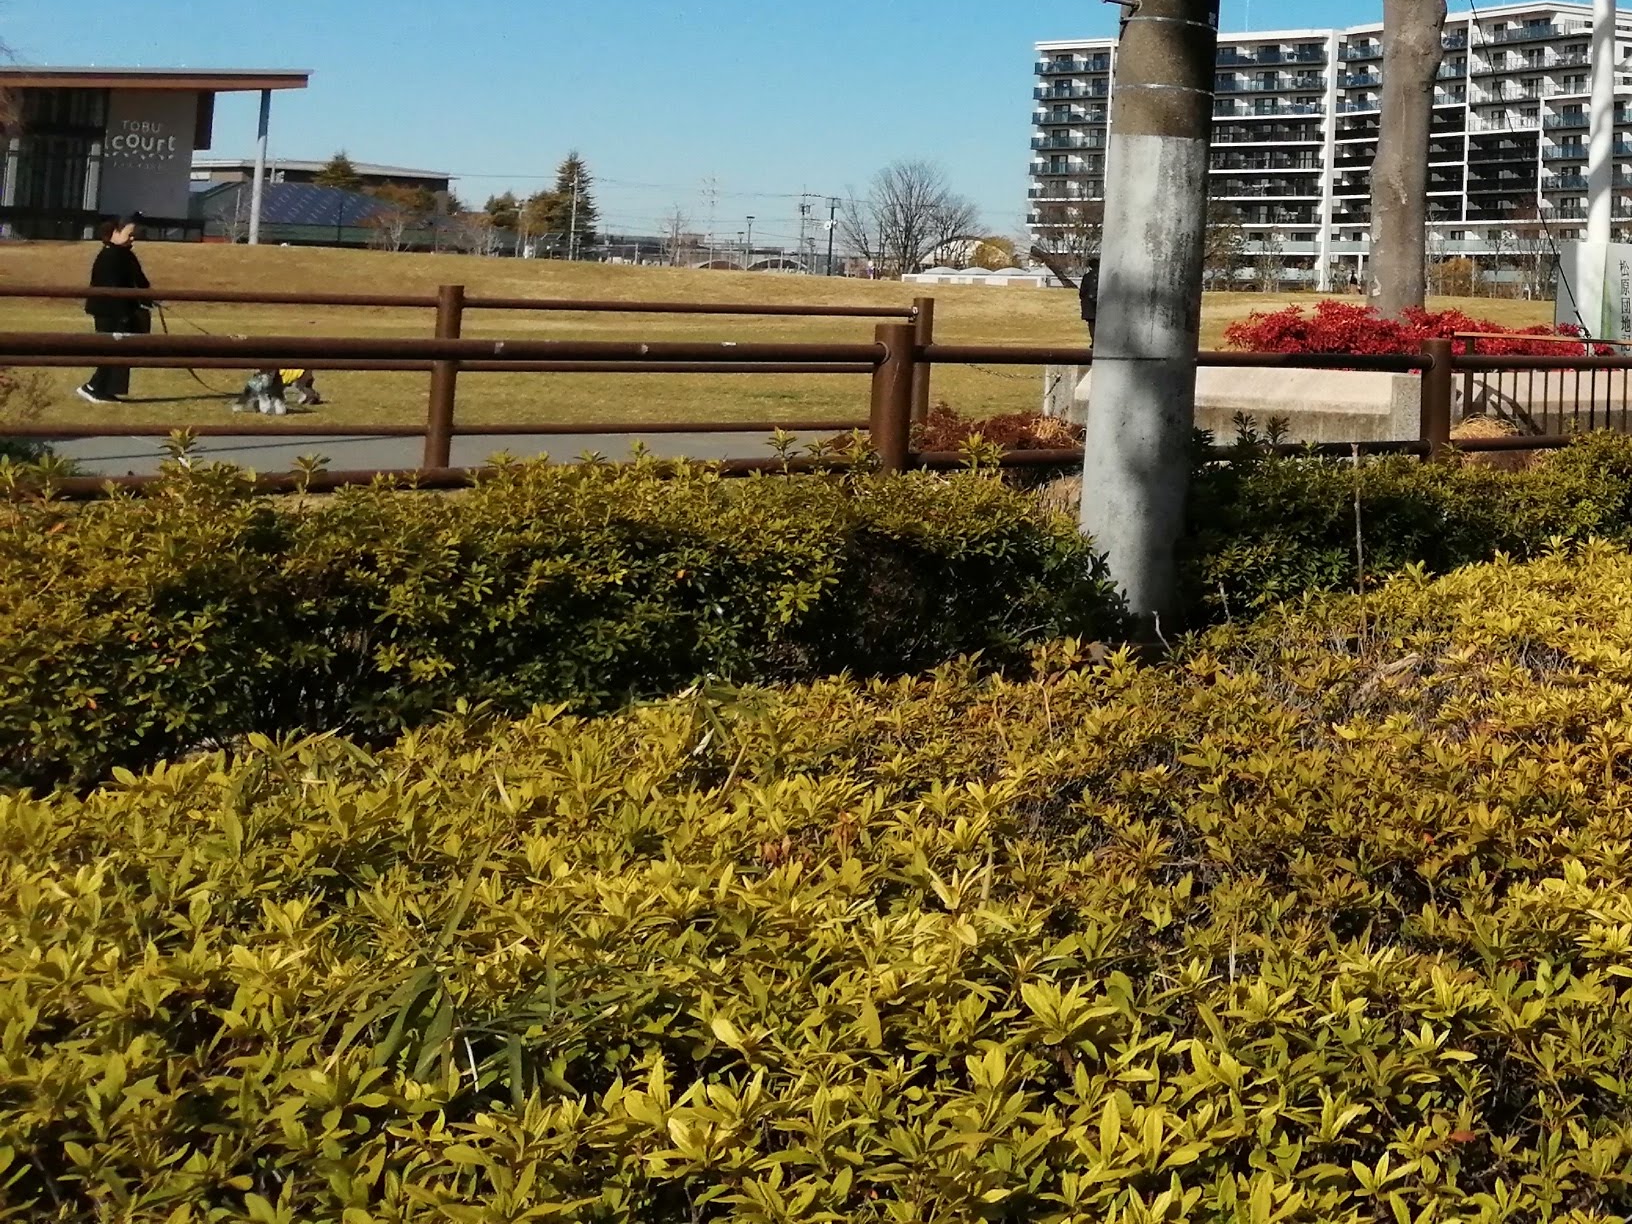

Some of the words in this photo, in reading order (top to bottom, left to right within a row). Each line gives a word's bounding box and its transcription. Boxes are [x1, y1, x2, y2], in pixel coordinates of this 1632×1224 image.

[122, 120, 162, 133] TOBU
[1619, 259, 1632, 357] 松原団地記
